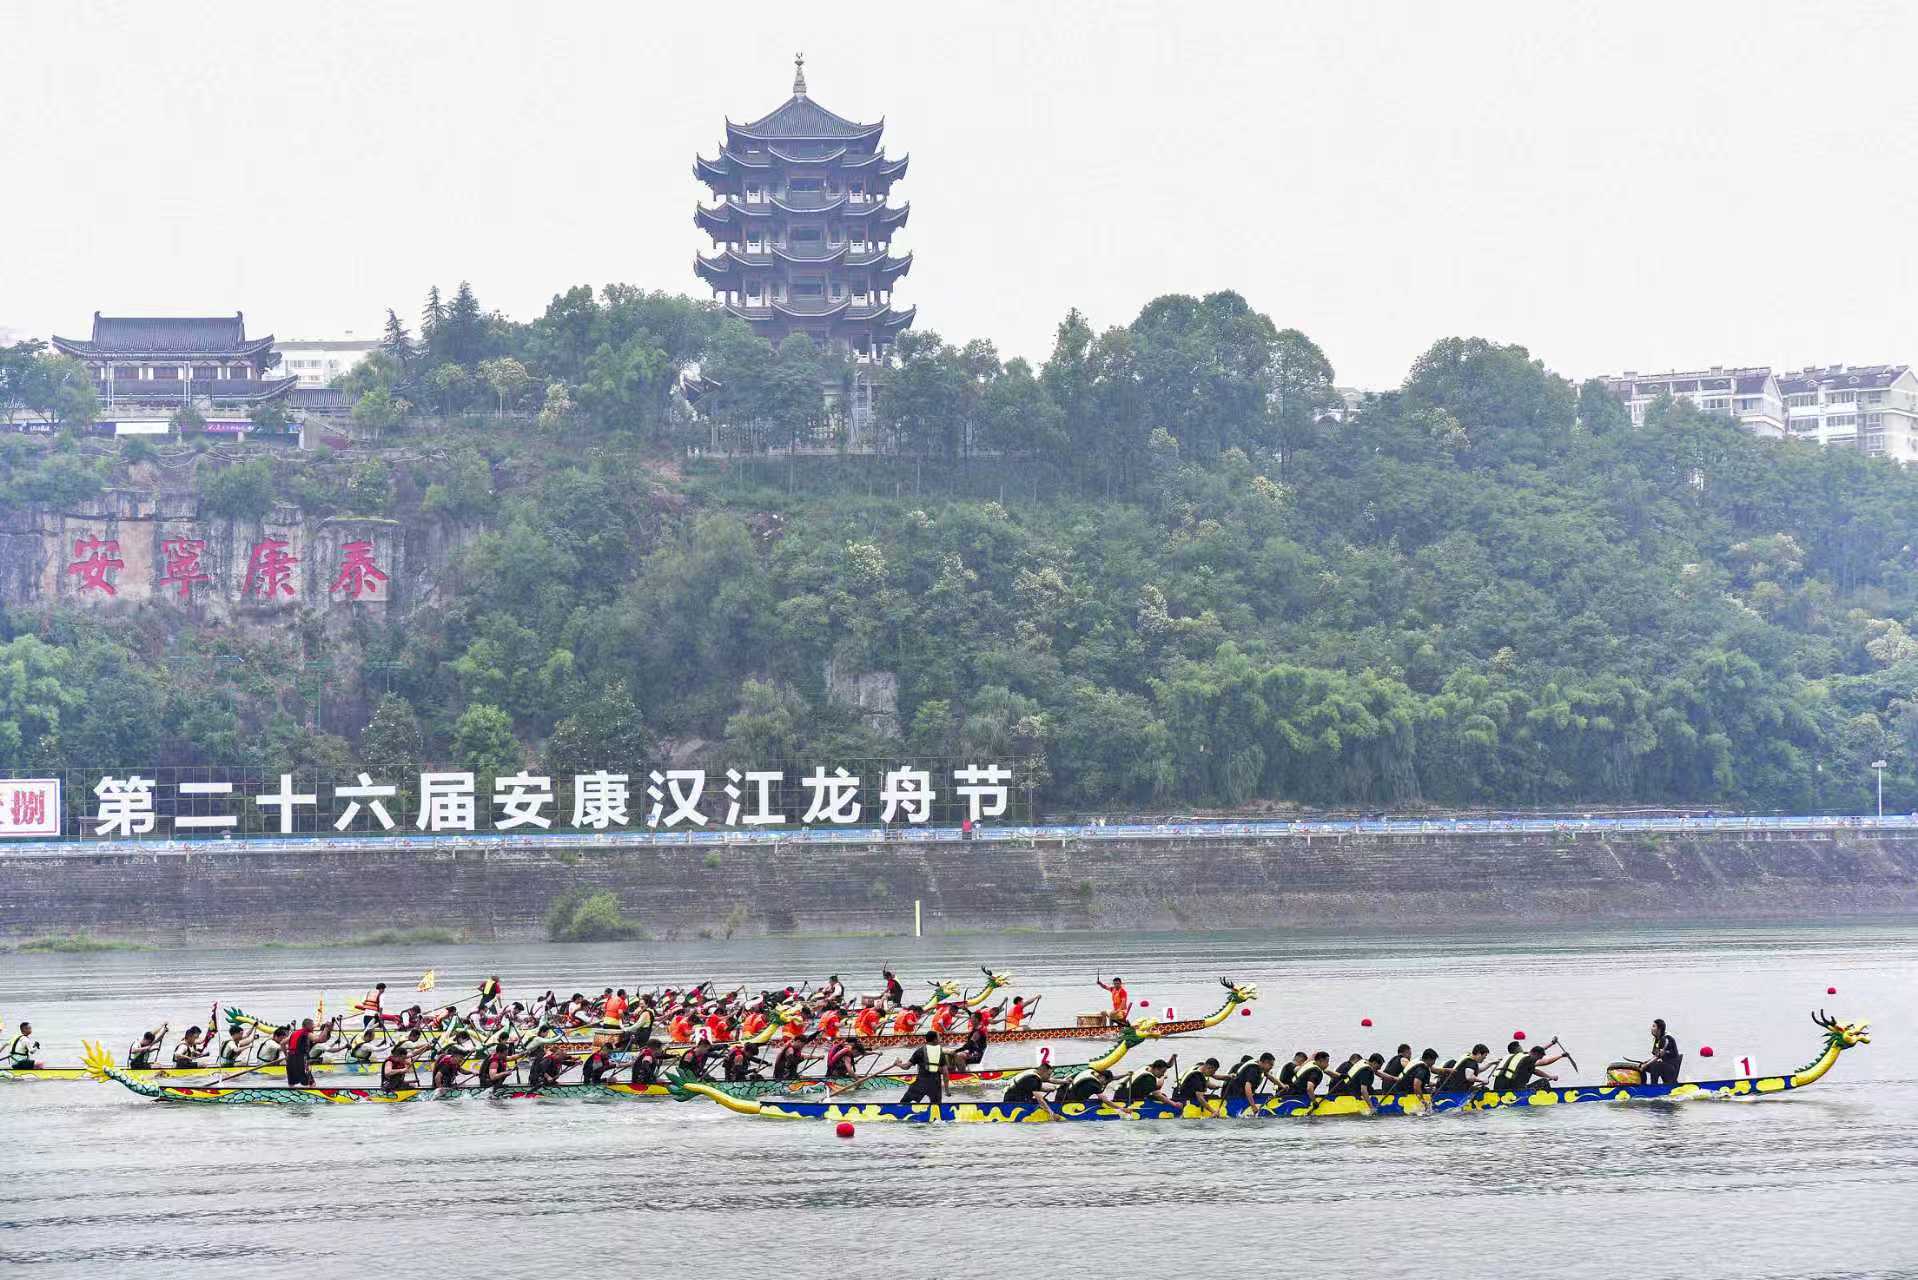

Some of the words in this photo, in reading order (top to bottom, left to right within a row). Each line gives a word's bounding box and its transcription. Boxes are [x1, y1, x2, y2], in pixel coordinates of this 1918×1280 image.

[94, 764, 1012, 837] 第二十六届安康汉江龙舟节
[1166, 1007, 1175, 1021] 4
[698, 1028, 708, 1040] 3
[1040, 1047, 1051, 1065] 2
[1740, 1056, 1751, 1076] 1
